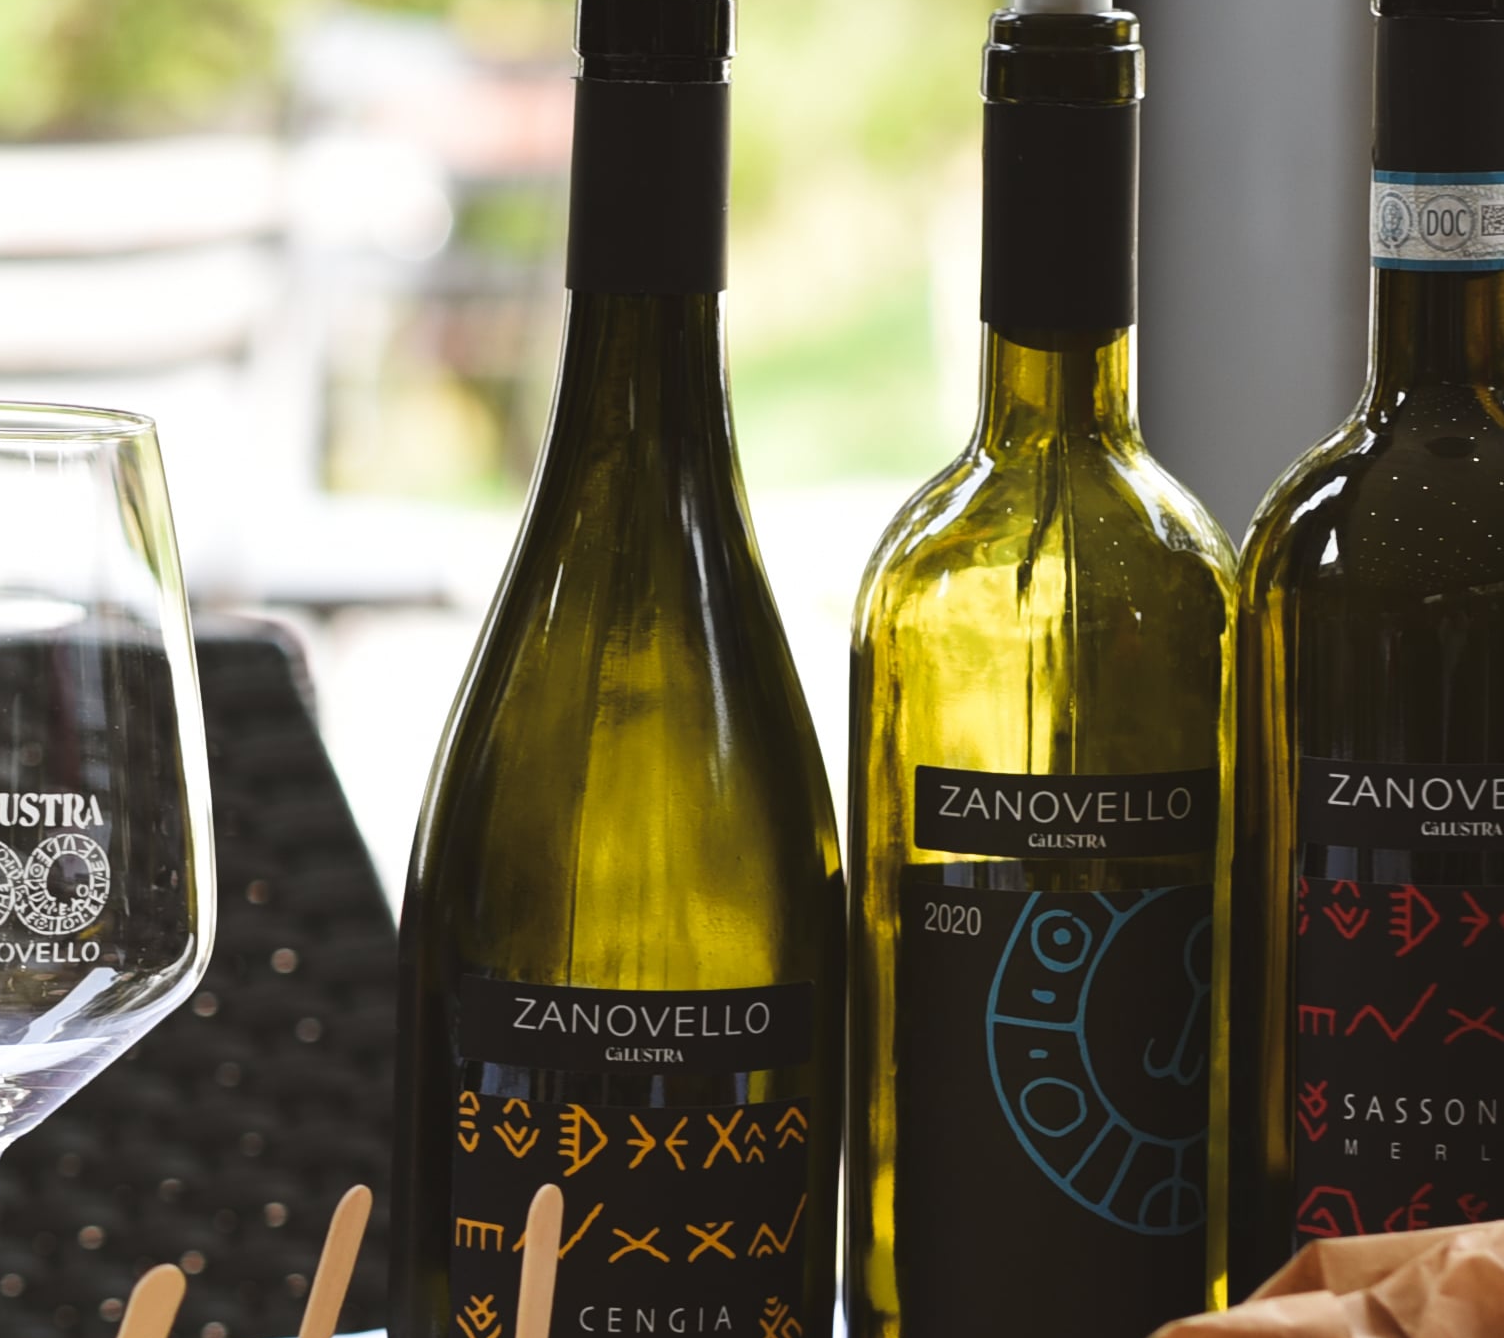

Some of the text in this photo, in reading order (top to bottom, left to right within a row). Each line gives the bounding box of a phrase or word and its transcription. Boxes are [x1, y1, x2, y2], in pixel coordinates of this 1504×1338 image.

[1426, 209, 1467, 237] DOC
[938, 784, 1192, 824] ZANOVELLO
[923, 901, 983, 937] 2020
[512, 996, 771, 1037] ZANOVELLO
[578, 1305, 734, 1333] CENGIA
